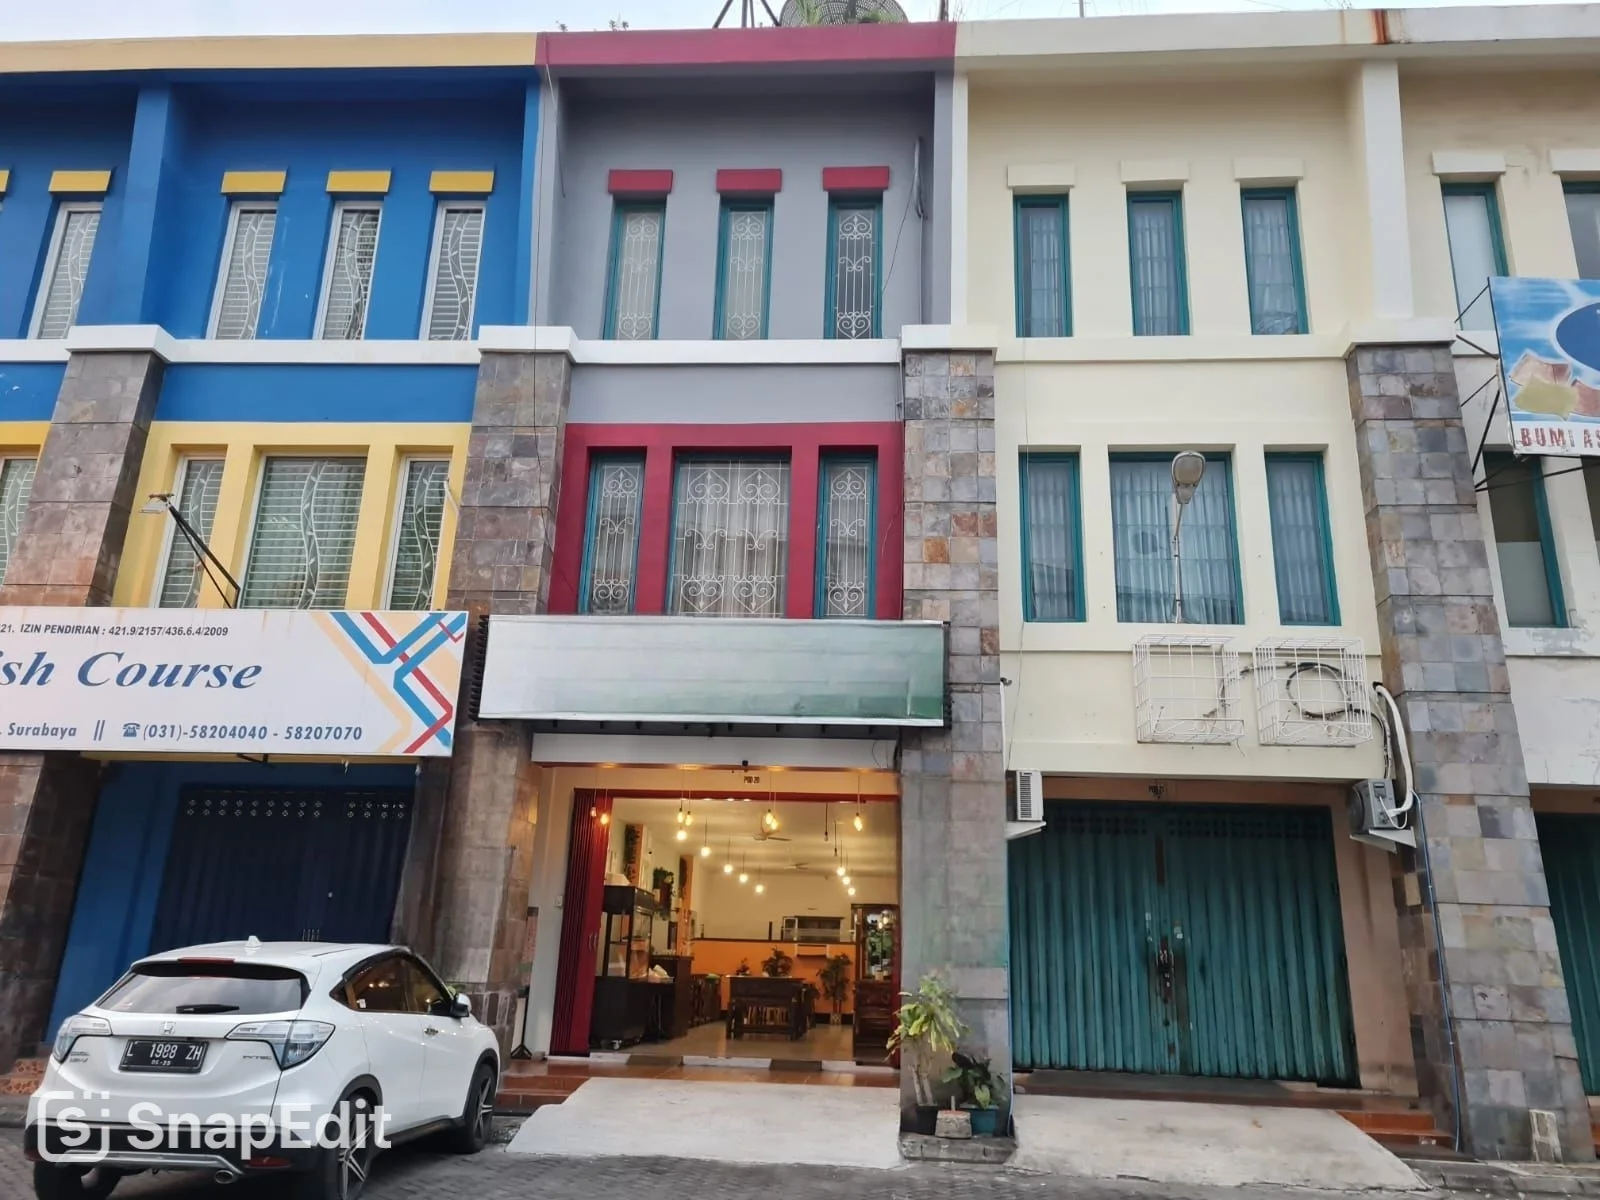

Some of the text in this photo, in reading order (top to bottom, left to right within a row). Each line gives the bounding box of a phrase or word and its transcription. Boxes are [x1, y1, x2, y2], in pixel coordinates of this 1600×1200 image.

[1520, 427, 1576, 448] BUMI
[0, 624, 14, 634] 21.
[20, 624, 42, 633] IZIN
[44, 624, 100, 635] PENDIRIAN
[108, 626, 229, 636] 421.9/2157/436.6.4/2009
[0, 650, 263, 689] sh Course
[7, 722, 77, 740] Surabaya
[143, 724, 268, 741] (031)-58204040
[284, 725, 363, 740] 58207070
[126, 1041, 203, 1060] L 1988 ZH
